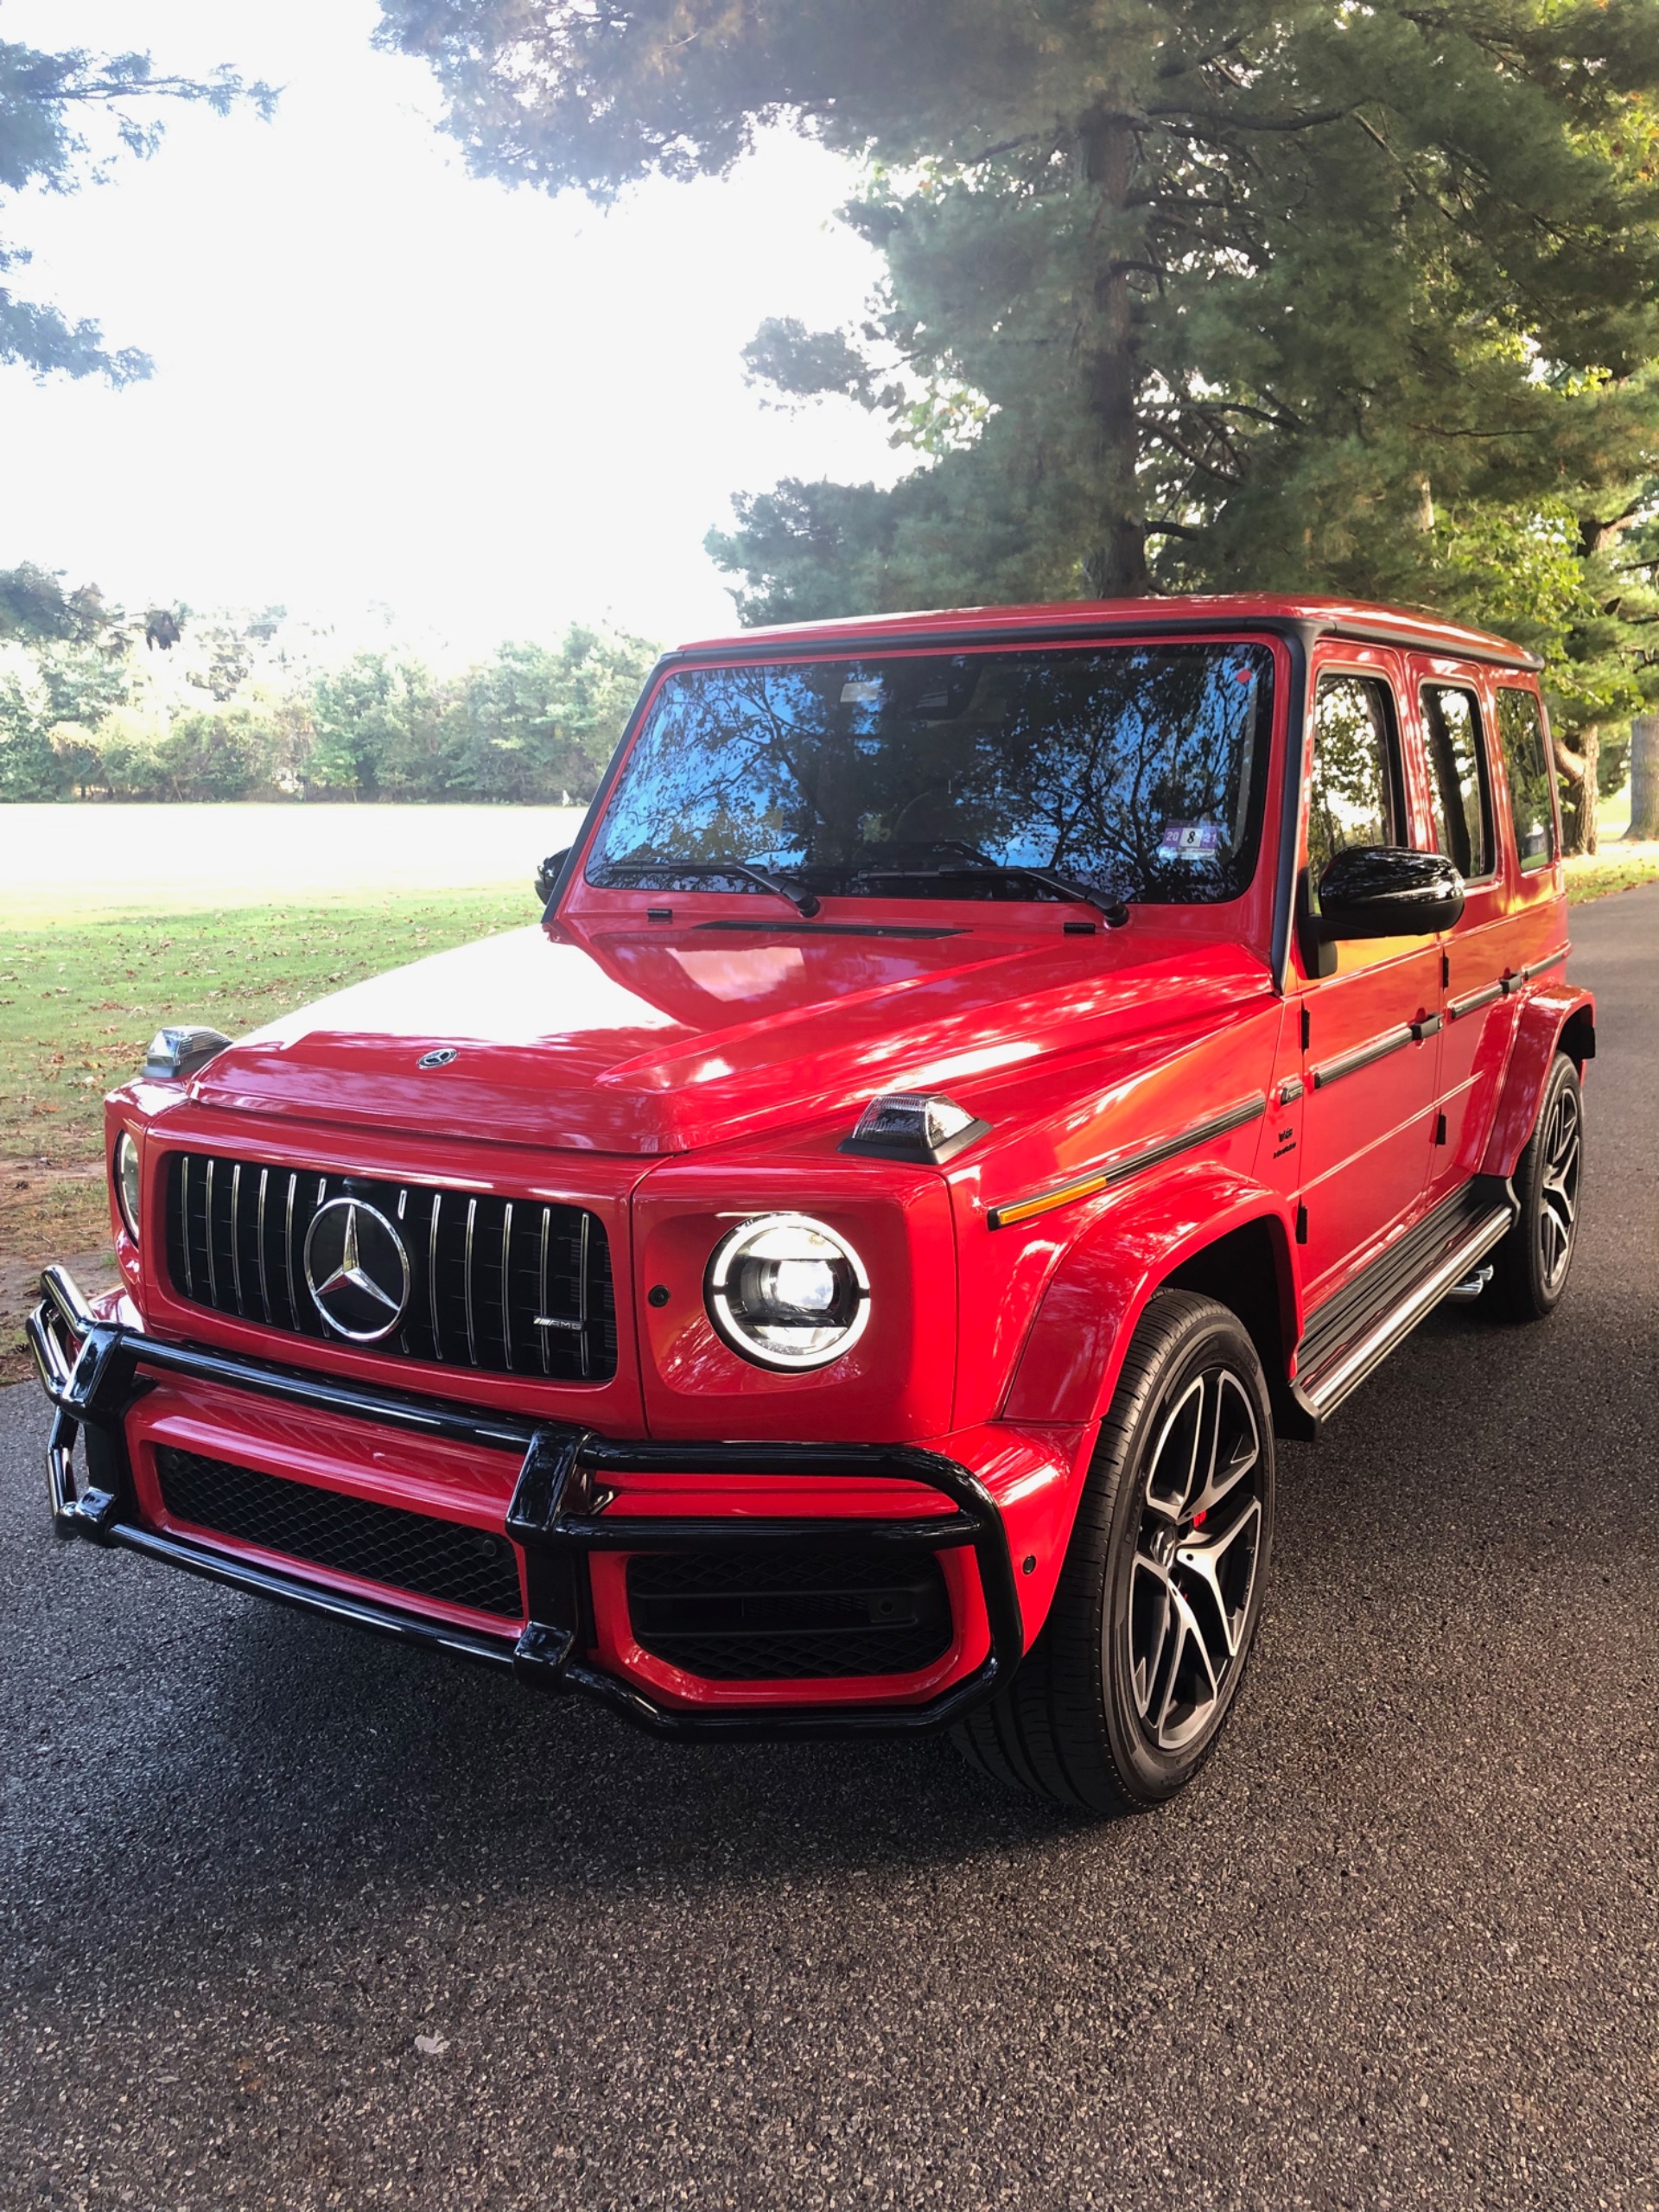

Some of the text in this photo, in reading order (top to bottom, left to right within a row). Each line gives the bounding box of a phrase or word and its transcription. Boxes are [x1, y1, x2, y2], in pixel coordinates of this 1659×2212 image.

[1166, 830, 1217, 844] 20 8 21
[548, 1319, 582, 1331] AMG
